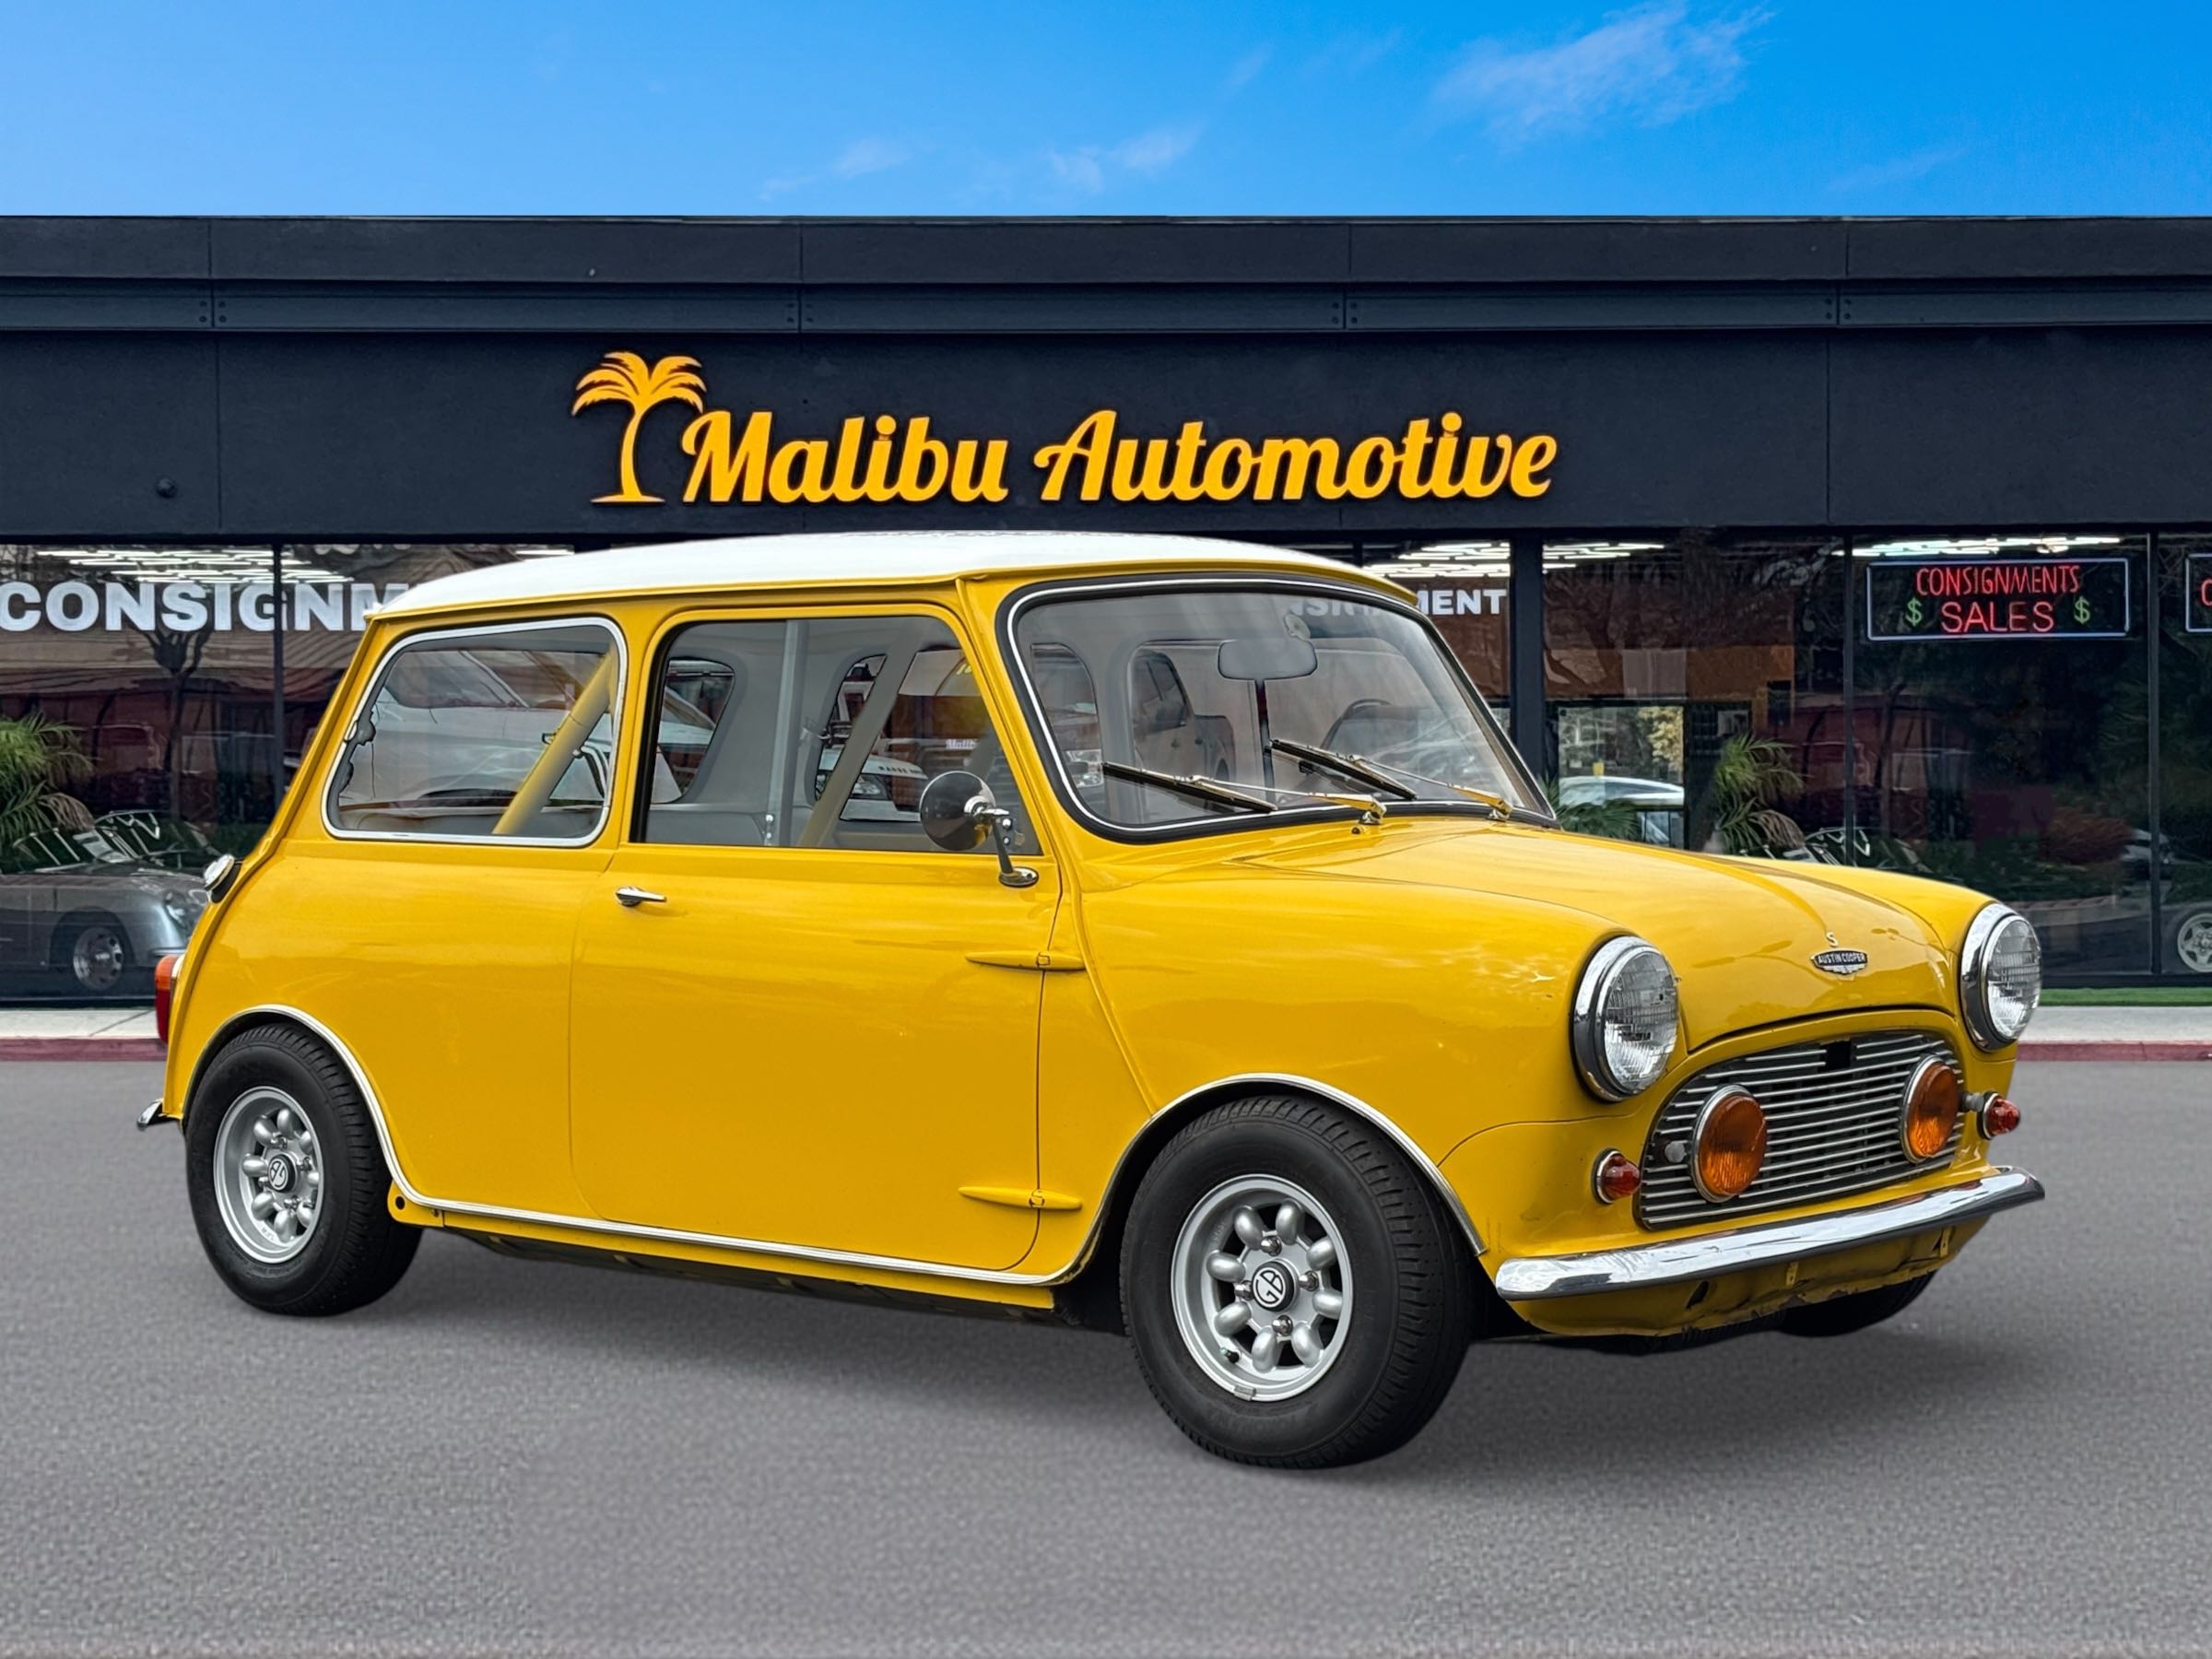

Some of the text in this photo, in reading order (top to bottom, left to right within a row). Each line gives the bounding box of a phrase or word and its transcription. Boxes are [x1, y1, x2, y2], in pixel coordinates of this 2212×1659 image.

[681, 409, 1558, 503] Malibu Automotive
[1915, 565, 2080, 596] CONSIGNMENTS
[1940, 600, 2055, 633] SALES
[1825, 931, 1839, 947] S
[1818, 952, 1866, 964] AUSTIN COOPER
